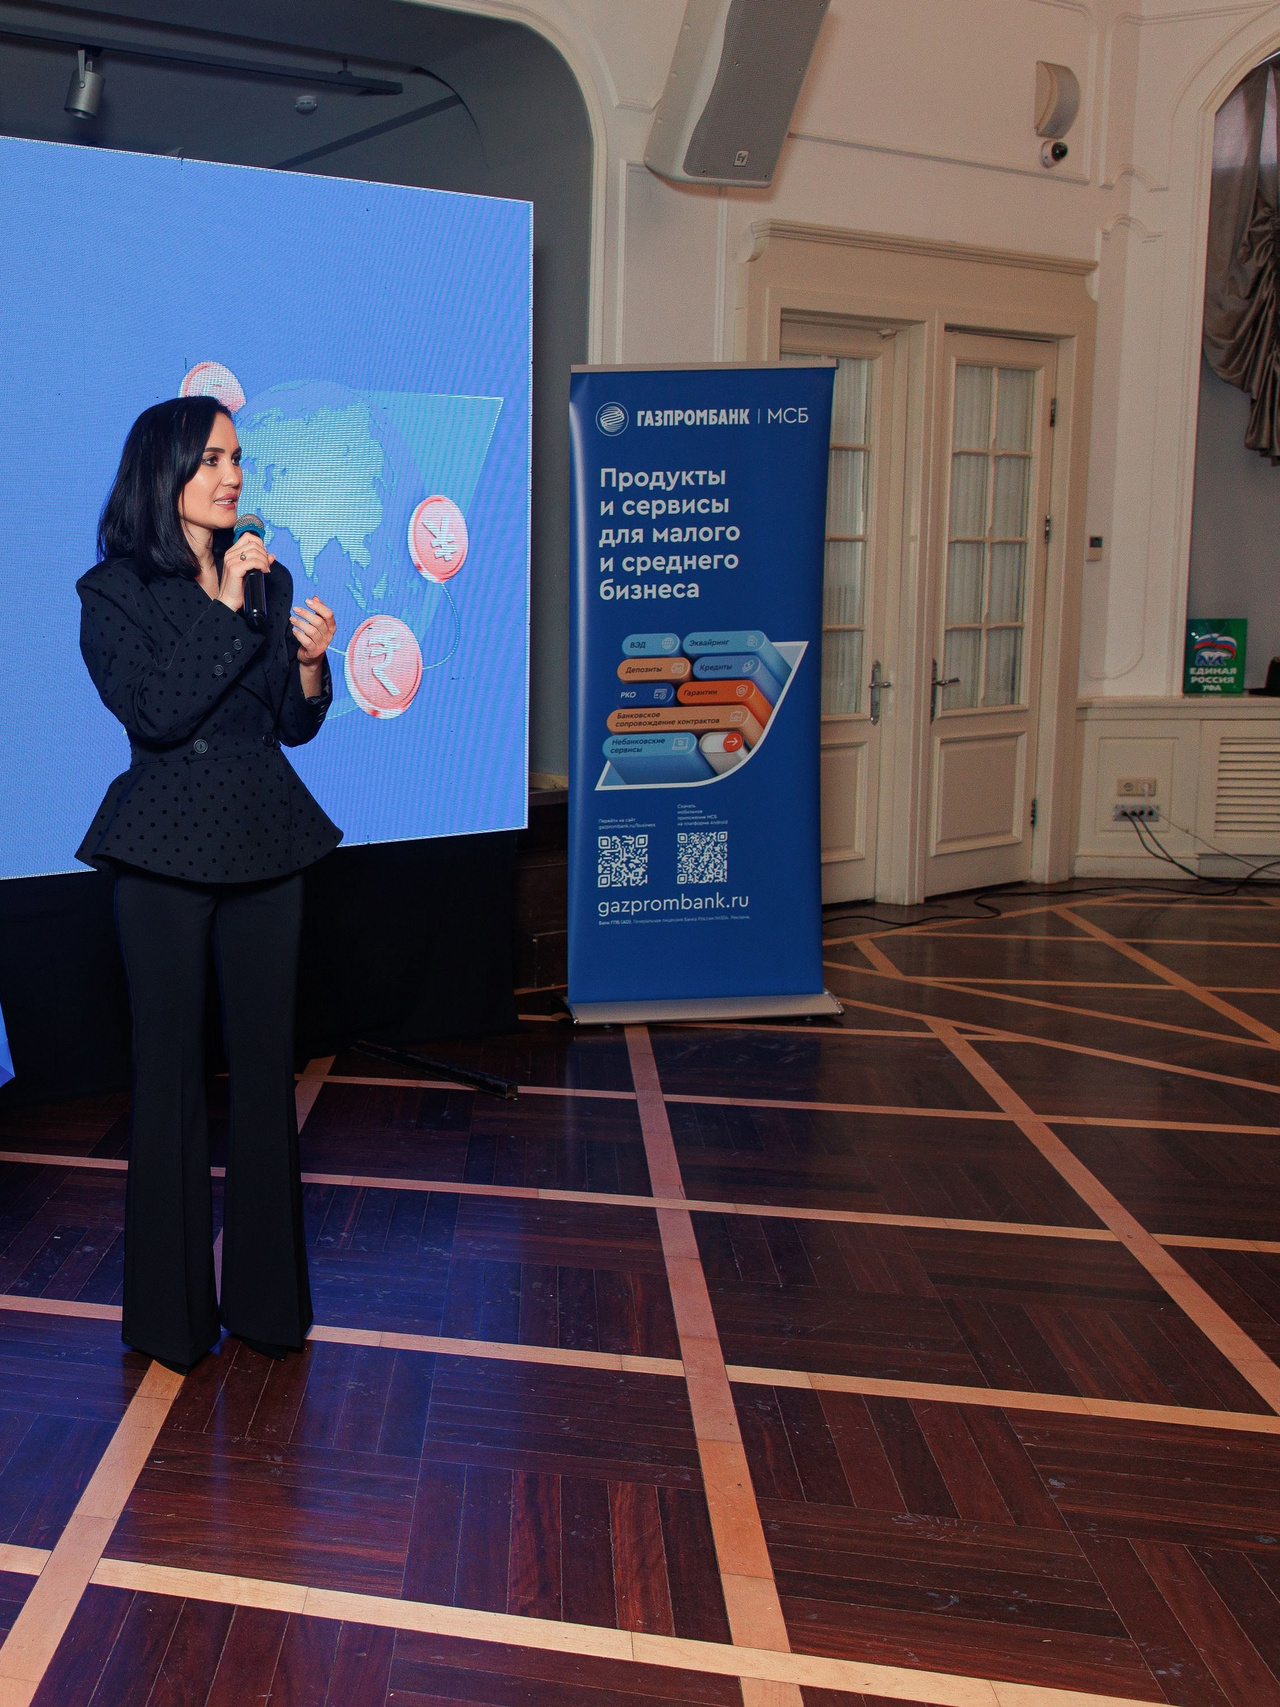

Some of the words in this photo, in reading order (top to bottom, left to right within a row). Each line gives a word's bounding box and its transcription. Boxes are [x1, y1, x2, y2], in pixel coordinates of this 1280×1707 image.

[637, 408, 750, 427] ГАЗПРОМБАНК
[767, 407, 809, 424] МСБ
[600, 468, 726, 492] Продукты
[600, 501, 614, 516] и
[622, 498, 730, 520] сервисы
[598, 528, 644, 548] для
[652, 525, 741, 543] малого
[600, 556, 614, 573] и
[622, 553, 739, 576] среднего
[599, 578, 700, 601] бизнеса
[629, 641, 646, 649] ВЭД
[626, 666, 662, 674] Депозиты
[1190, 667, 1237, 675] ЕДИНАЯ
[1191, 676, 1235, 684] РОССИЯ
[683, 689, 718, 697] Гарантии
[616, 711, 661, 720] Банковское
[615, 719, 675, 729] сопровождение
[677, 717, 720, 726] контрактов
[612, 737, 666, 747] Небанковские
[610, 746, 643, 755] сервисы
[598, 891, 749, 917] gazprombank.ru
